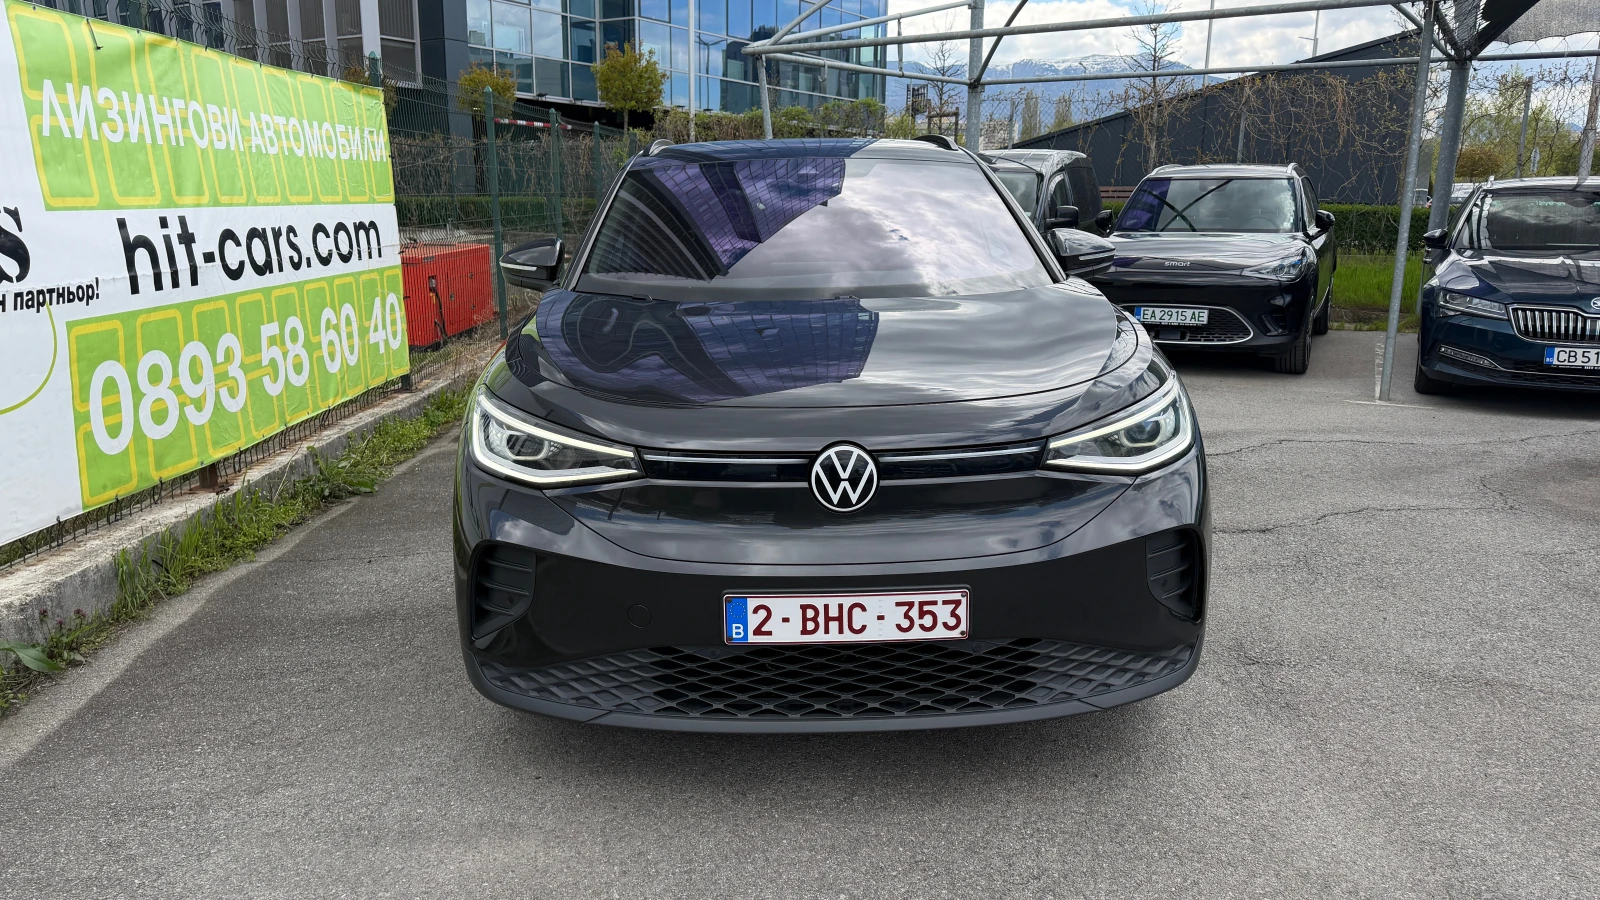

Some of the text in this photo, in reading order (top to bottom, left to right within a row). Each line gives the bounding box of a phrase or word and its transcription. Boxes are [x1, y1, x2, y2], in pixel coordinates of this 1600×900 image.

[42, 79, 387, 163] ЛИЗИНГОВИ АВТОМОБИЛИ
[116, 215, 383, 295] hit-cars.com
[13, 276, 100, 314] партньор!
[1142, 309, 1206, 323] EA 2915 AE
[89, 292, 402, 455] 0893 58 60 40
[1556, 349, 1578, 364] CB
[731, 623, 745, 639] B
